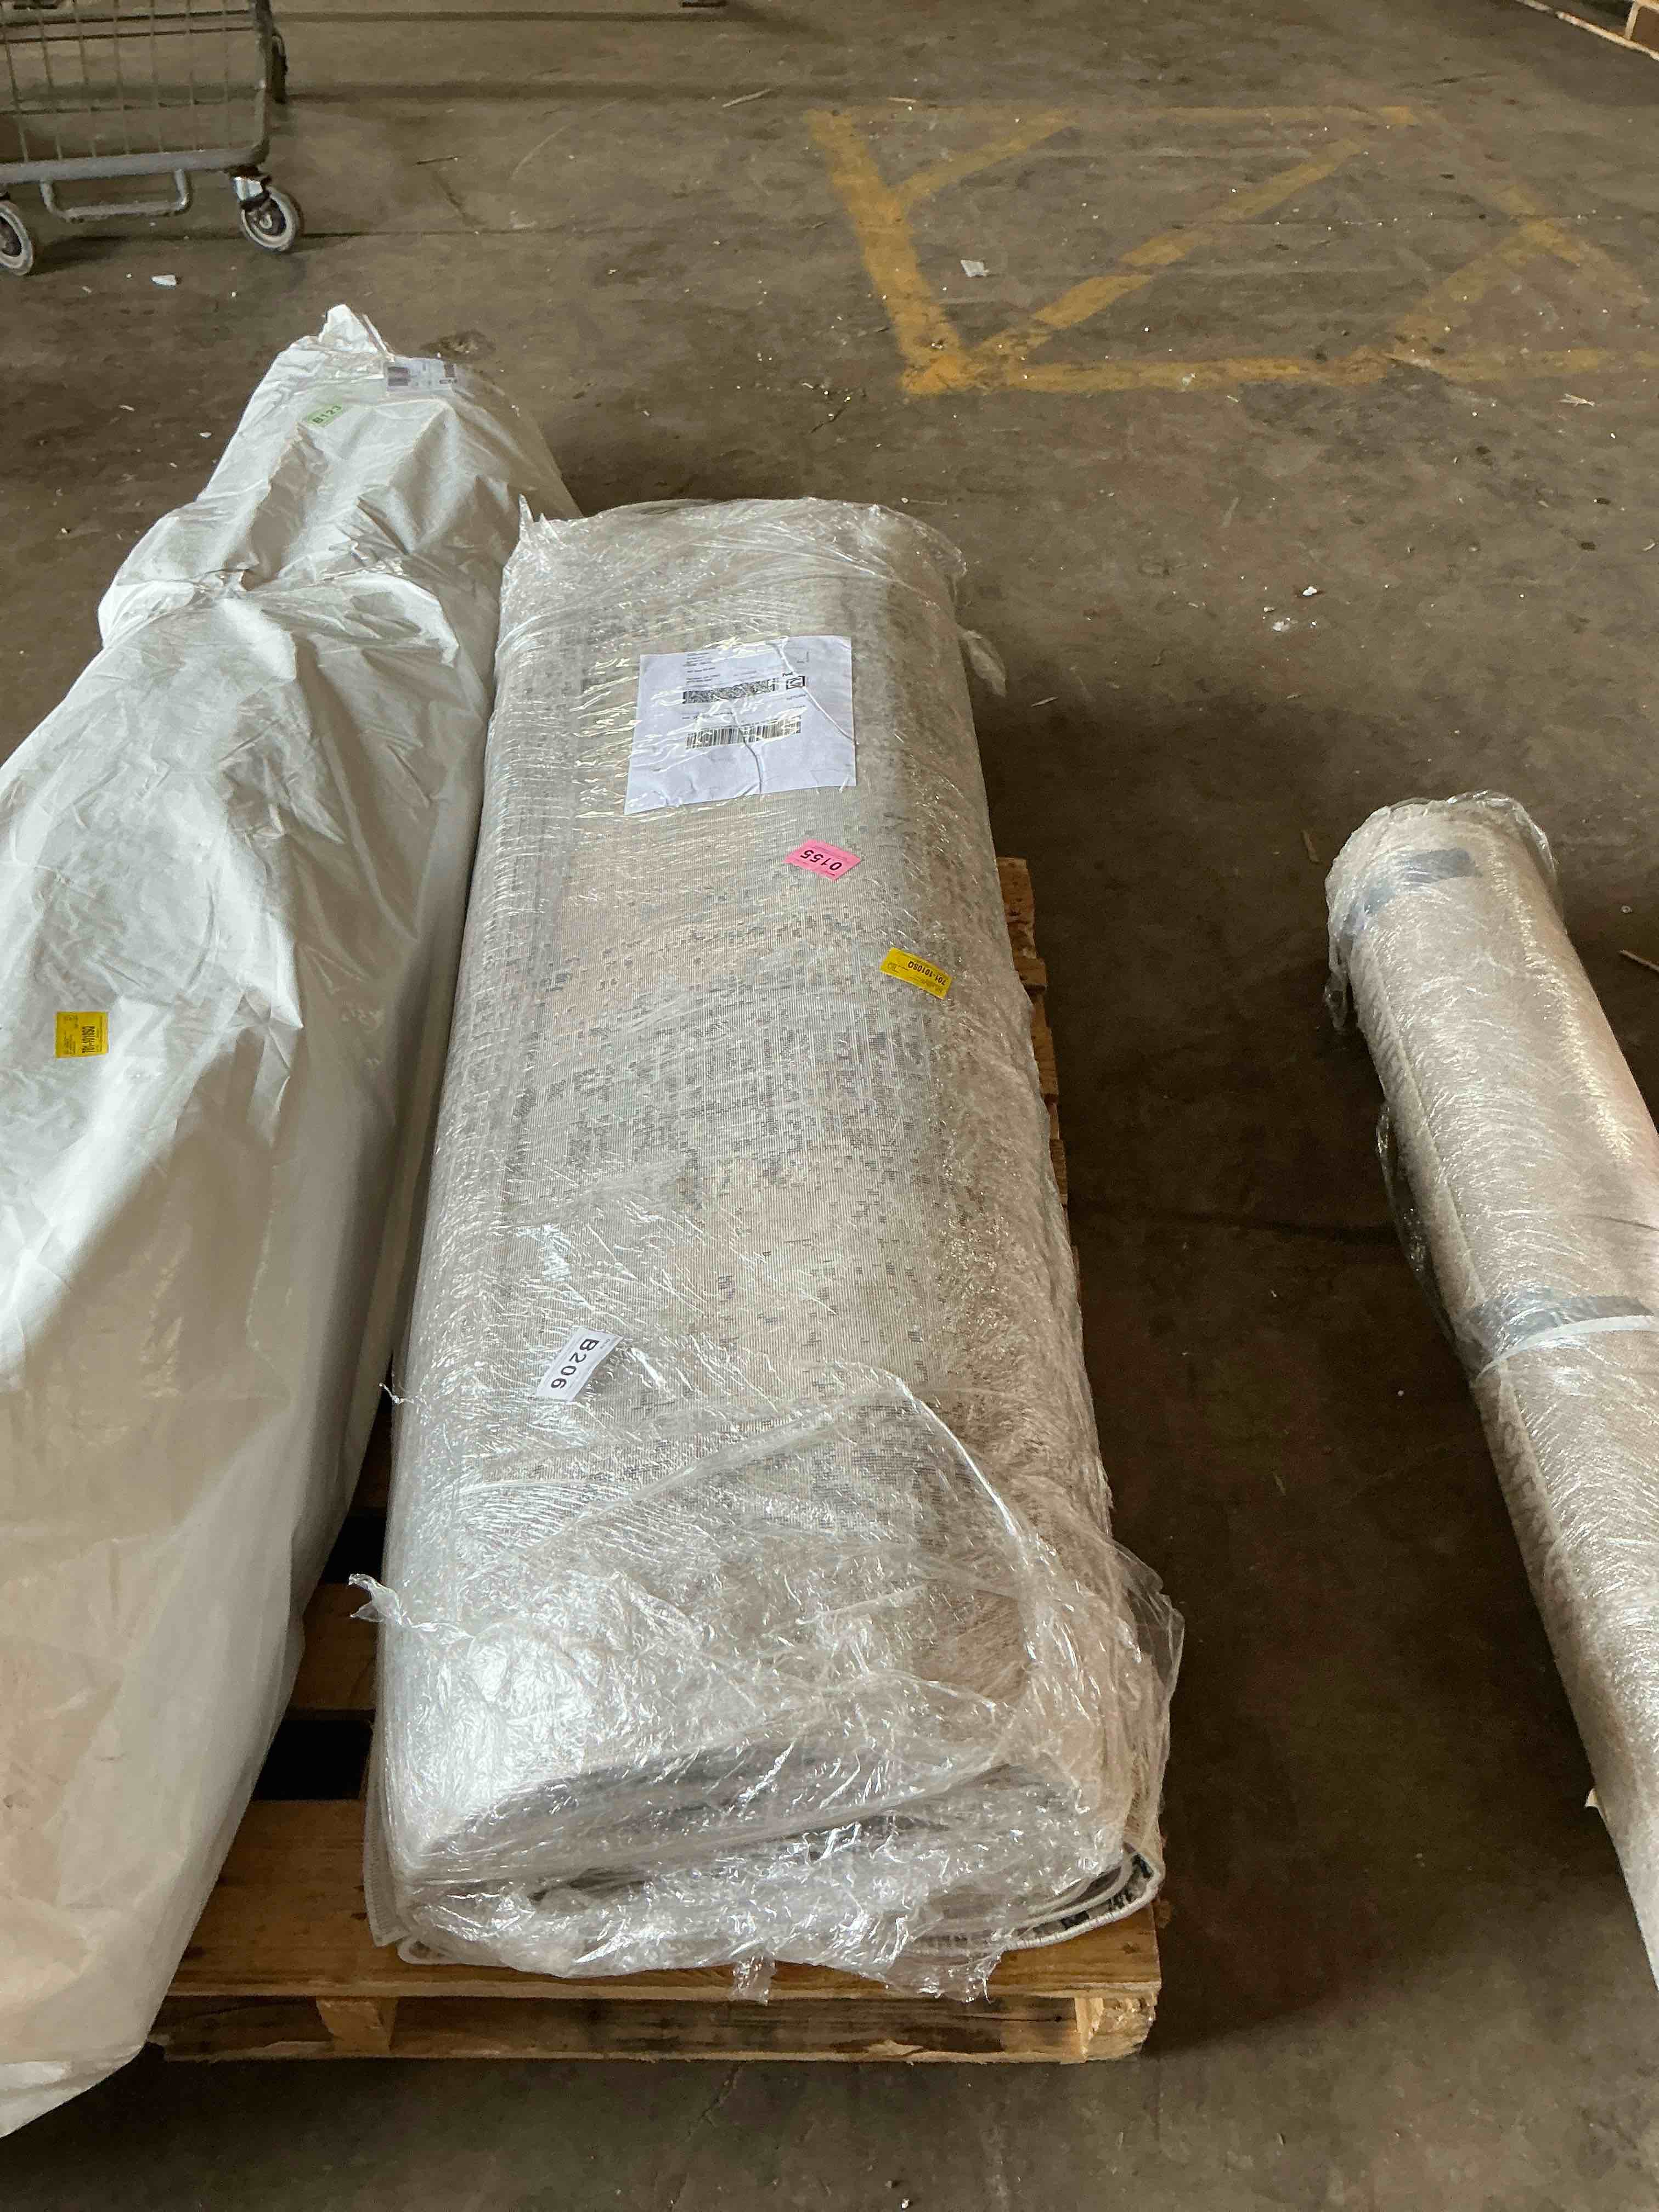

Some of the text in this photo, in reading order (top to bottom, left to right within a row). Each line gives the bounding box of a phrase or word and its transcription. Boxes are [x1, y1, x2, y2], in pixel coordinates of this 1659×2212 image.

[312, 405, 342, 424] B123
[799, 850, 842, 871] 0155
[550, 1338, 600, 1389] B206
